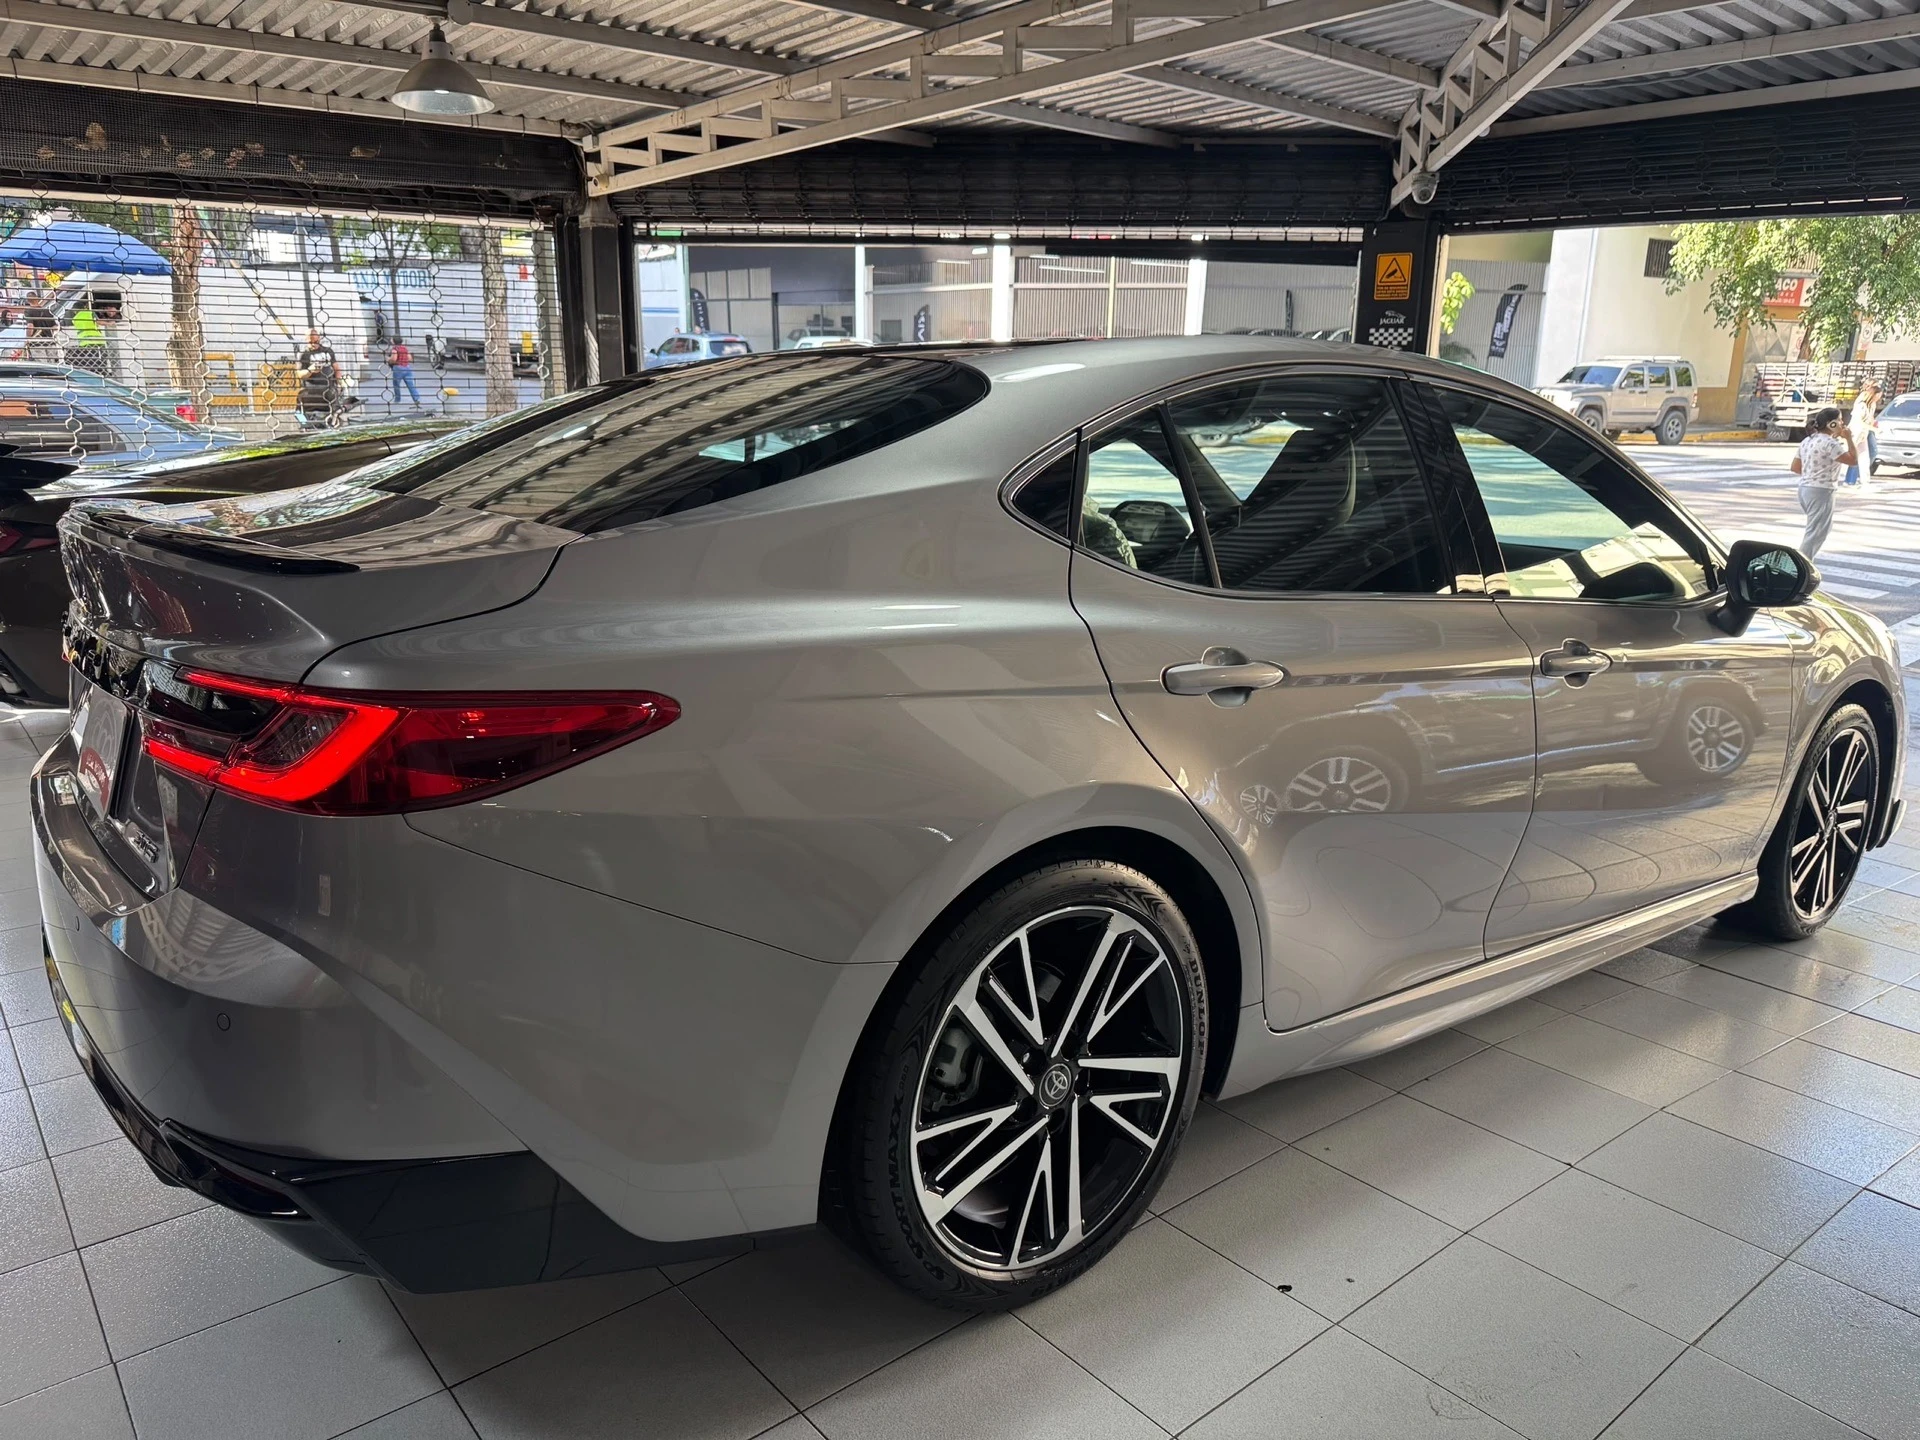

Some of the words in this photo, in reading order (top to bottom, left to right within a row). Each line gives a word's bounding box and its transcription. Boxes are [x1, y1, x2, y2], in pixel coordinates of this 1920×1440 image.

[1379, 317, 1405, 325] JAGUAR
[1188, 957, 1206, 1056] DUNLOP
[887, 1096, 904, 1188] MAXX
[891, 1191, 925, 1260] SPORT
